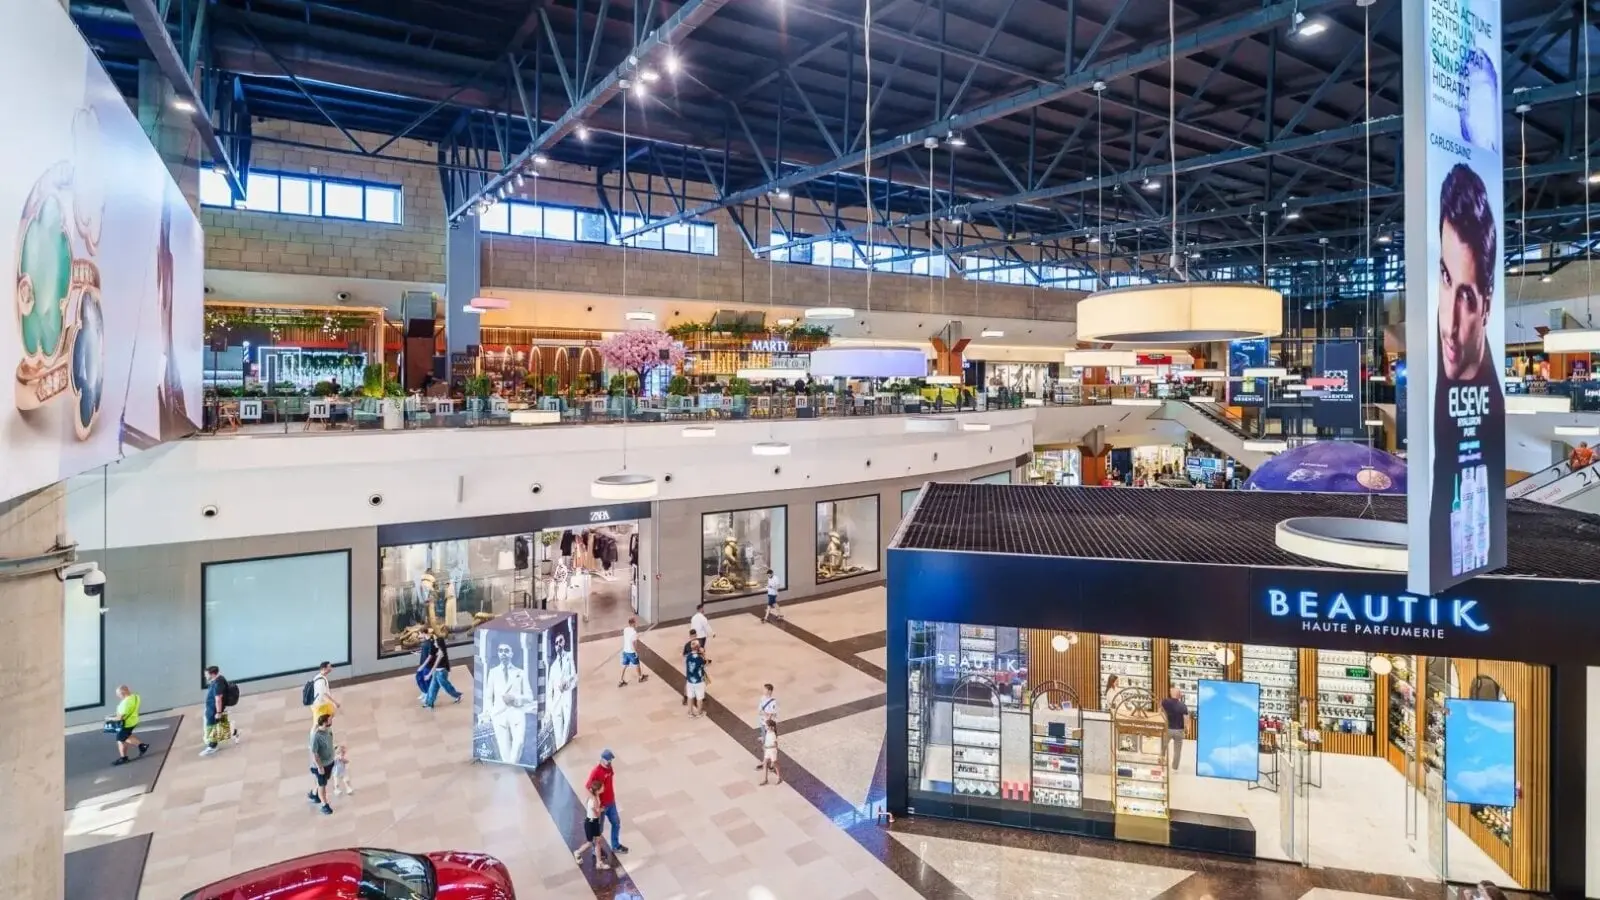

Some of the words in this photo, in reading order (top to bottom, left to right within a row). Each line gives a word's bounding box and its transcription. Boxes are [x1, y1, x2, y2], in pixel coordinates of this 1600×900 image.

[1432, 6, 1463, 39] PENTRU
[1464, 27, 1476, 47] UN
[1432, 27, 1458, 53] SCALP
[1432, 66, 1470, 101] HIDRATAT
[1430, 132, 1454, 153] CARLOS
[752, 339, 789, 351] MARTY
[1448, 386, 1489, 417] ELSEVE
[590, 510, 610, 522] ZARA
[1268, 589, 1490, 632] BEAUTIK
[1302, 621, 1347, 633] HAUTE
[1355, 624, 1445, 639] PARFUMERIE
[936, 653, 1021, 673] BEAUTIK
